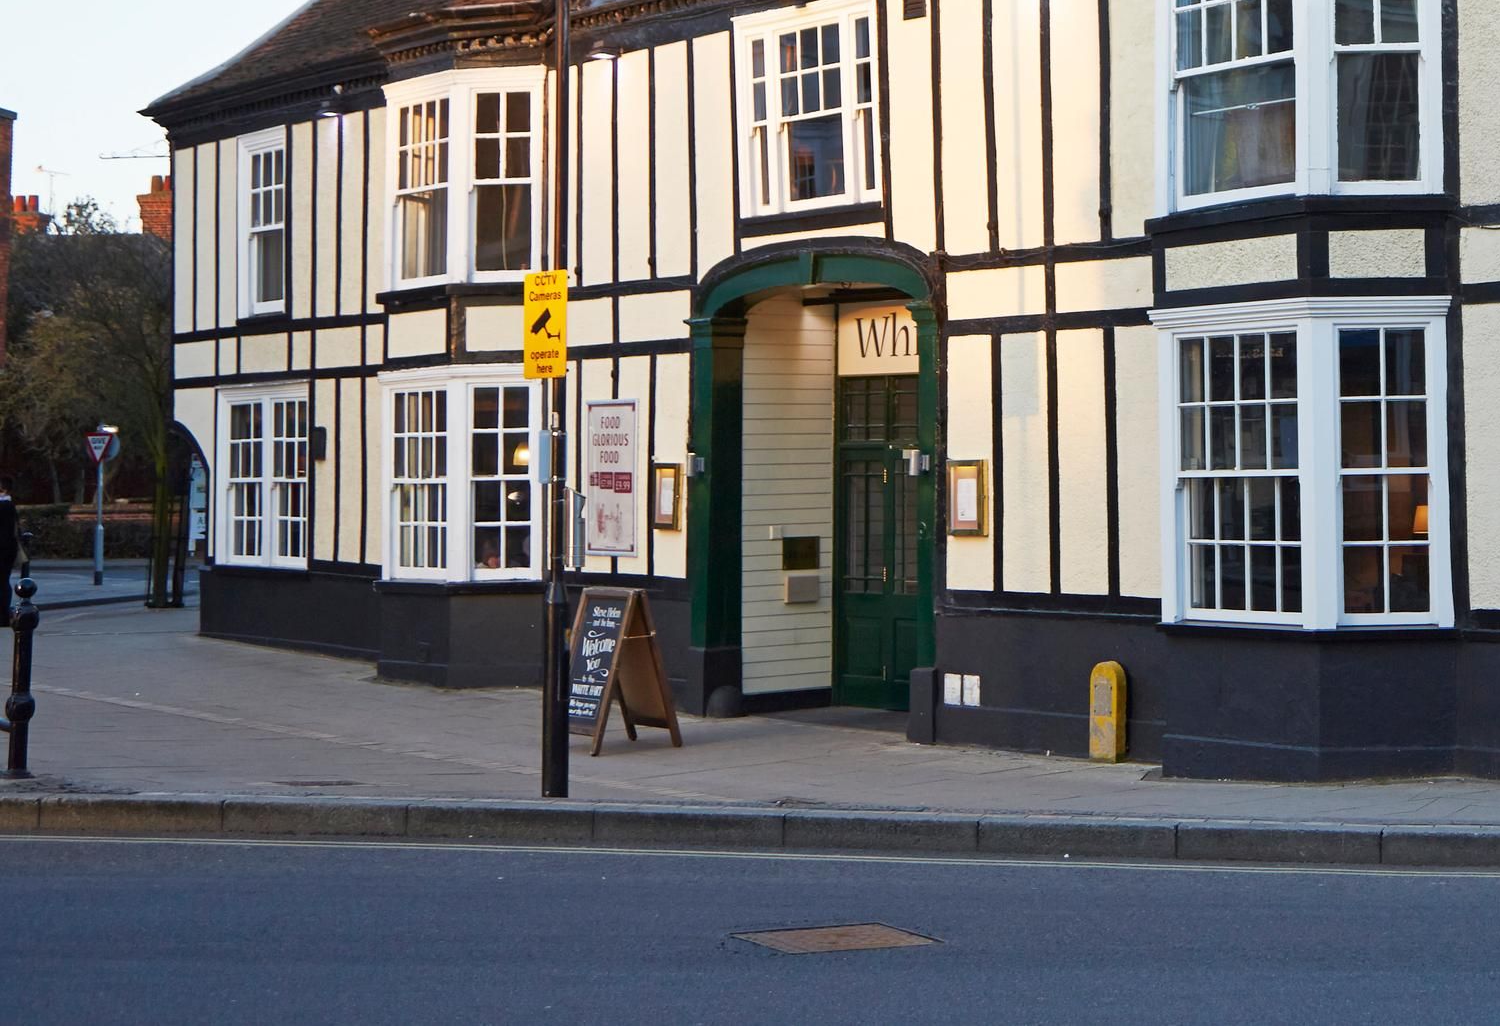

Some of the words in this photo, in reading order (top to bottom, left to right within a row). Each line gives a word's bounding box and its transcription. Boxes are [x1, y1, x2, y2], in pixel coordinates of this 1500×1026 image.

[535, 275, 557, 286] CCTV
[529, 291, 562, 302] Cameras
[530, 349, 560, 361] operate
[536, 363, 553, 374] here
[600, 416, 620, 429] FOOD
[592, 433, 629, 447] GLORIOUS
[600, 450, 619, 464] FOOD
[582, 636, 616, 656] Welcome
[586, 658, 601, 672] You
